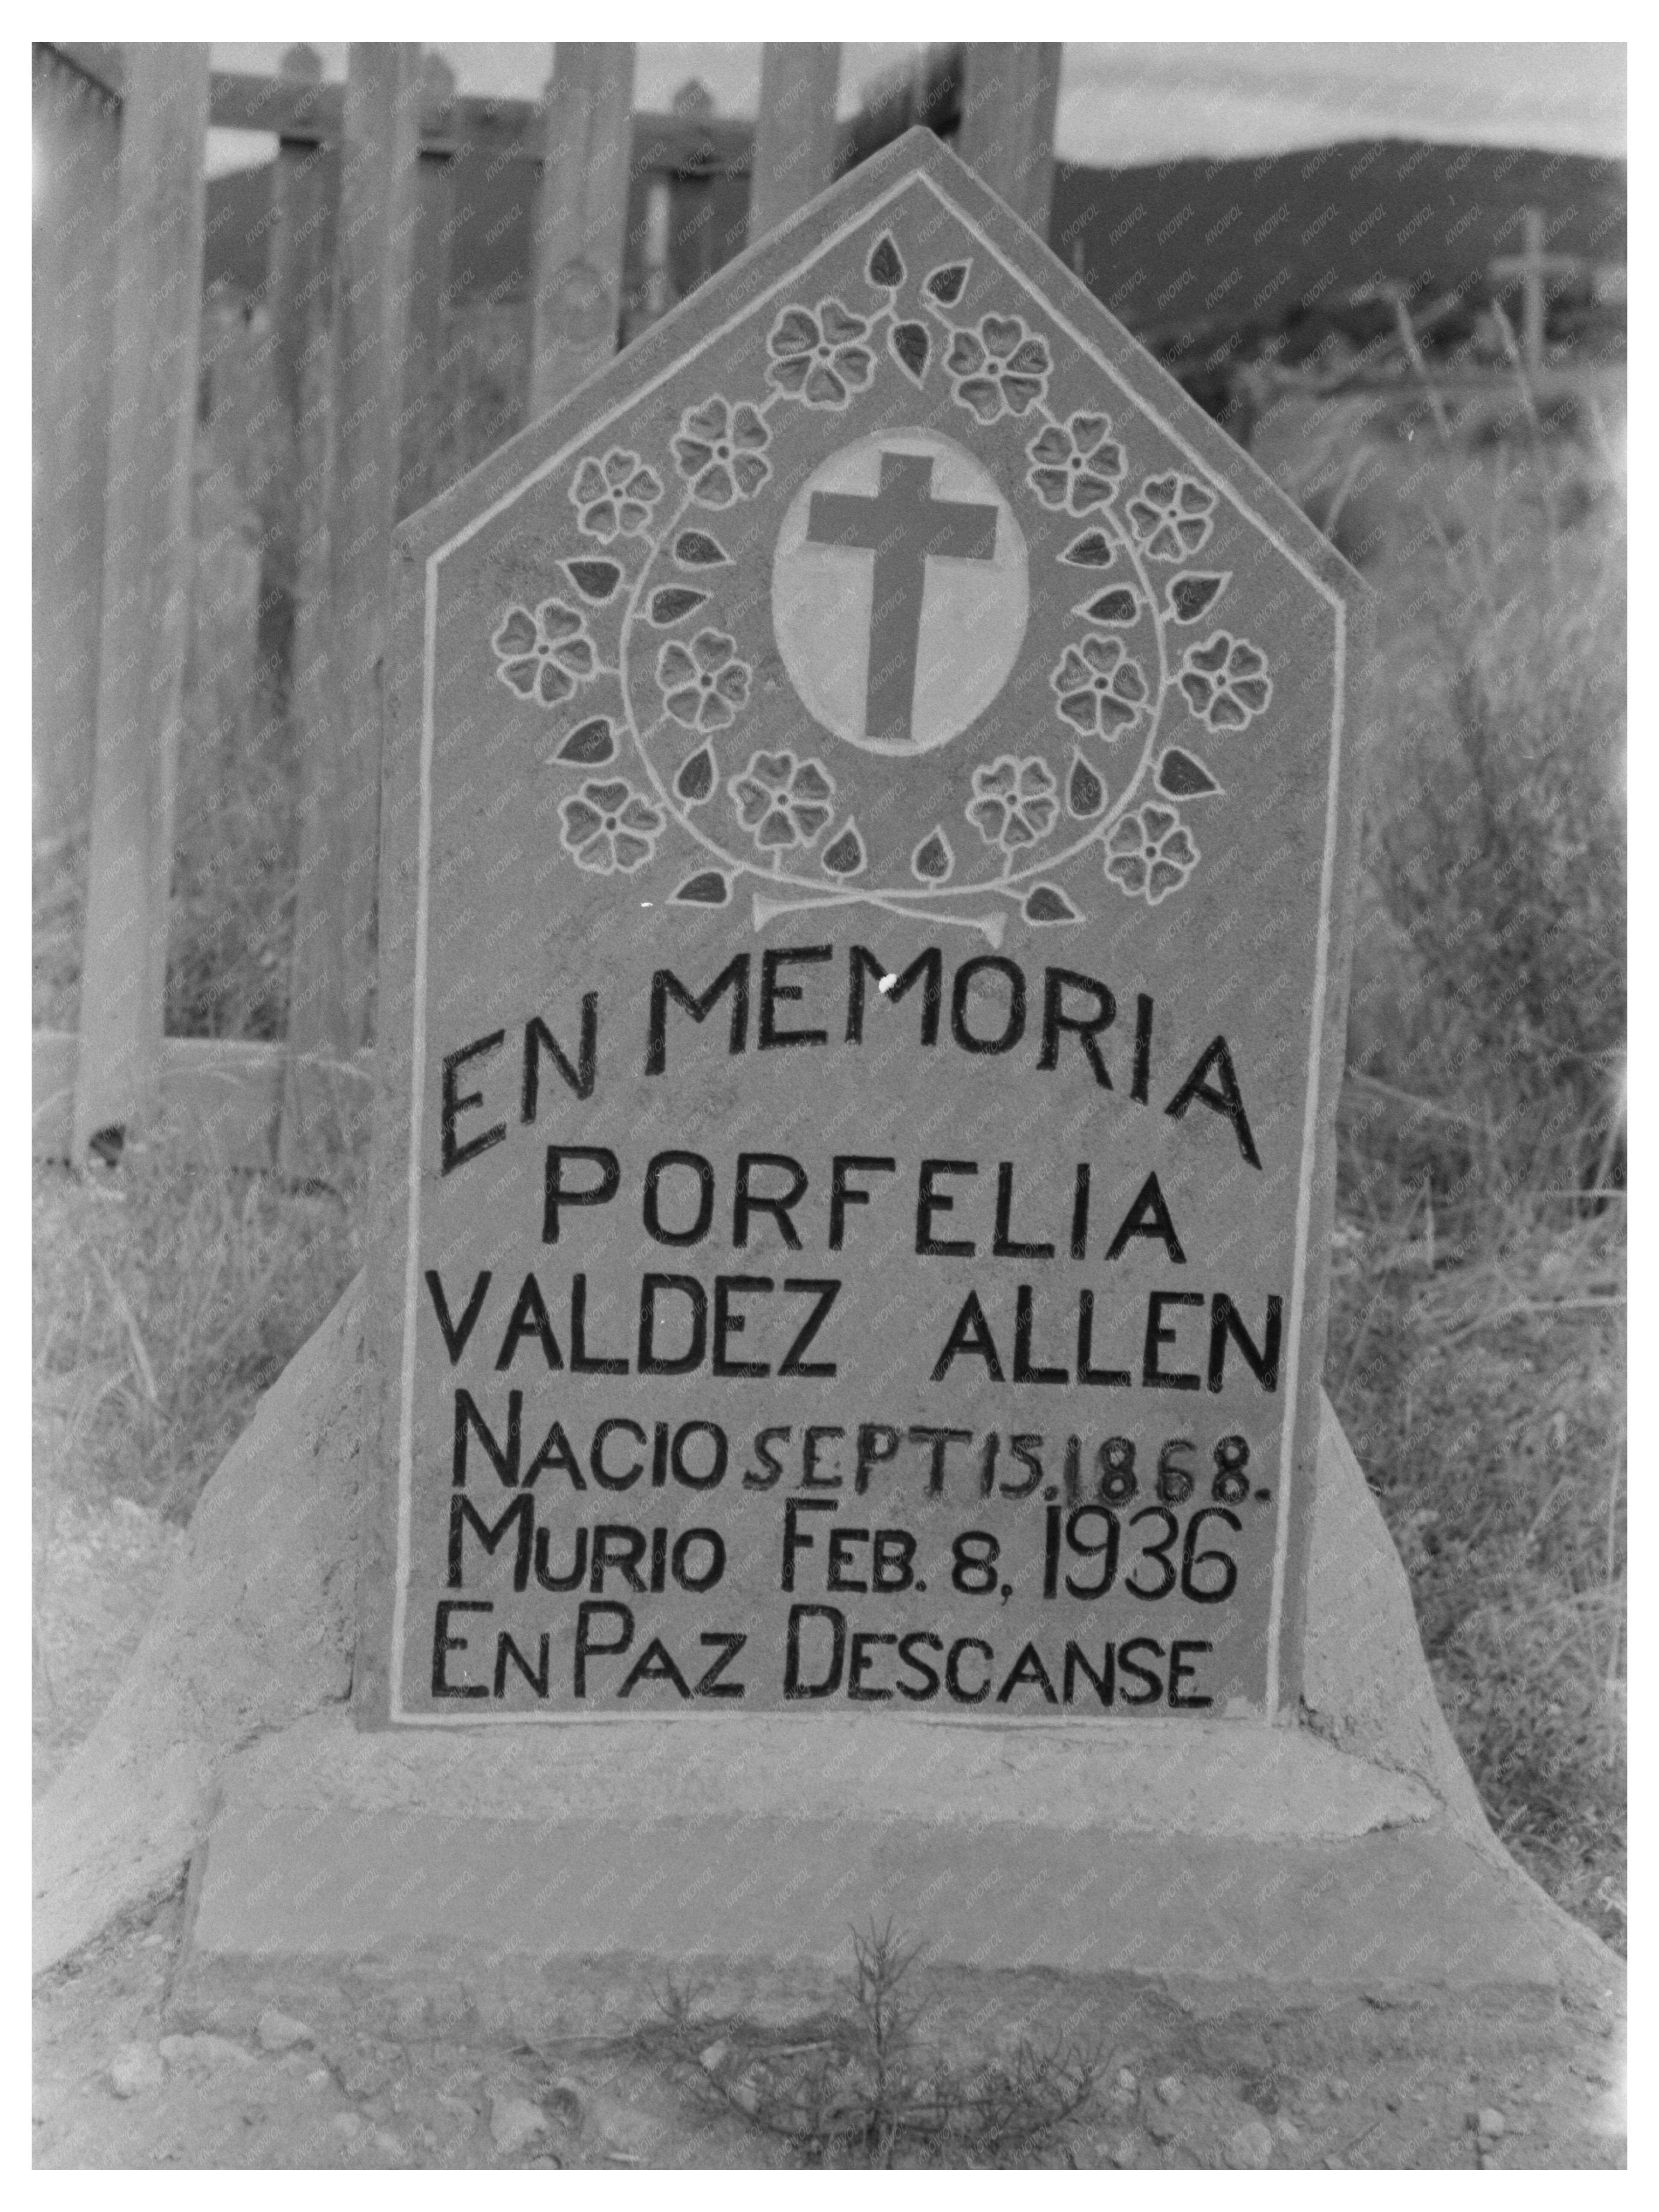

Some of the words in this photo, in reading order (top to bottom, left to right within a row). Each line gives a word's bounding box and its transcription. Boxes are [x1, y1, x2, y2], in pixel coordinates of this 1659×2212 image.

[440, 990, 599, 1177] EN
[643, 943, 1263, 1172] MEMORIA
[541, 1144, 1188, 1266] PORFELIA
[424, 1269, 843, 1379] VALDEZ
[929, 1282, 1284, 1396] ALLEN
[451, 1387, 730, 1493] NACIO
[446, 1491, 728, 1594] MURIO
[779, 1496, 928, 1596] FEB.
[1043, 1504, 1245, 1606] 1936
[430, 1598, 551, 1699] EN
[573, 1598, 748, 1700] PAZ
[782, 1601, 1215, 1710] DESCANSE
